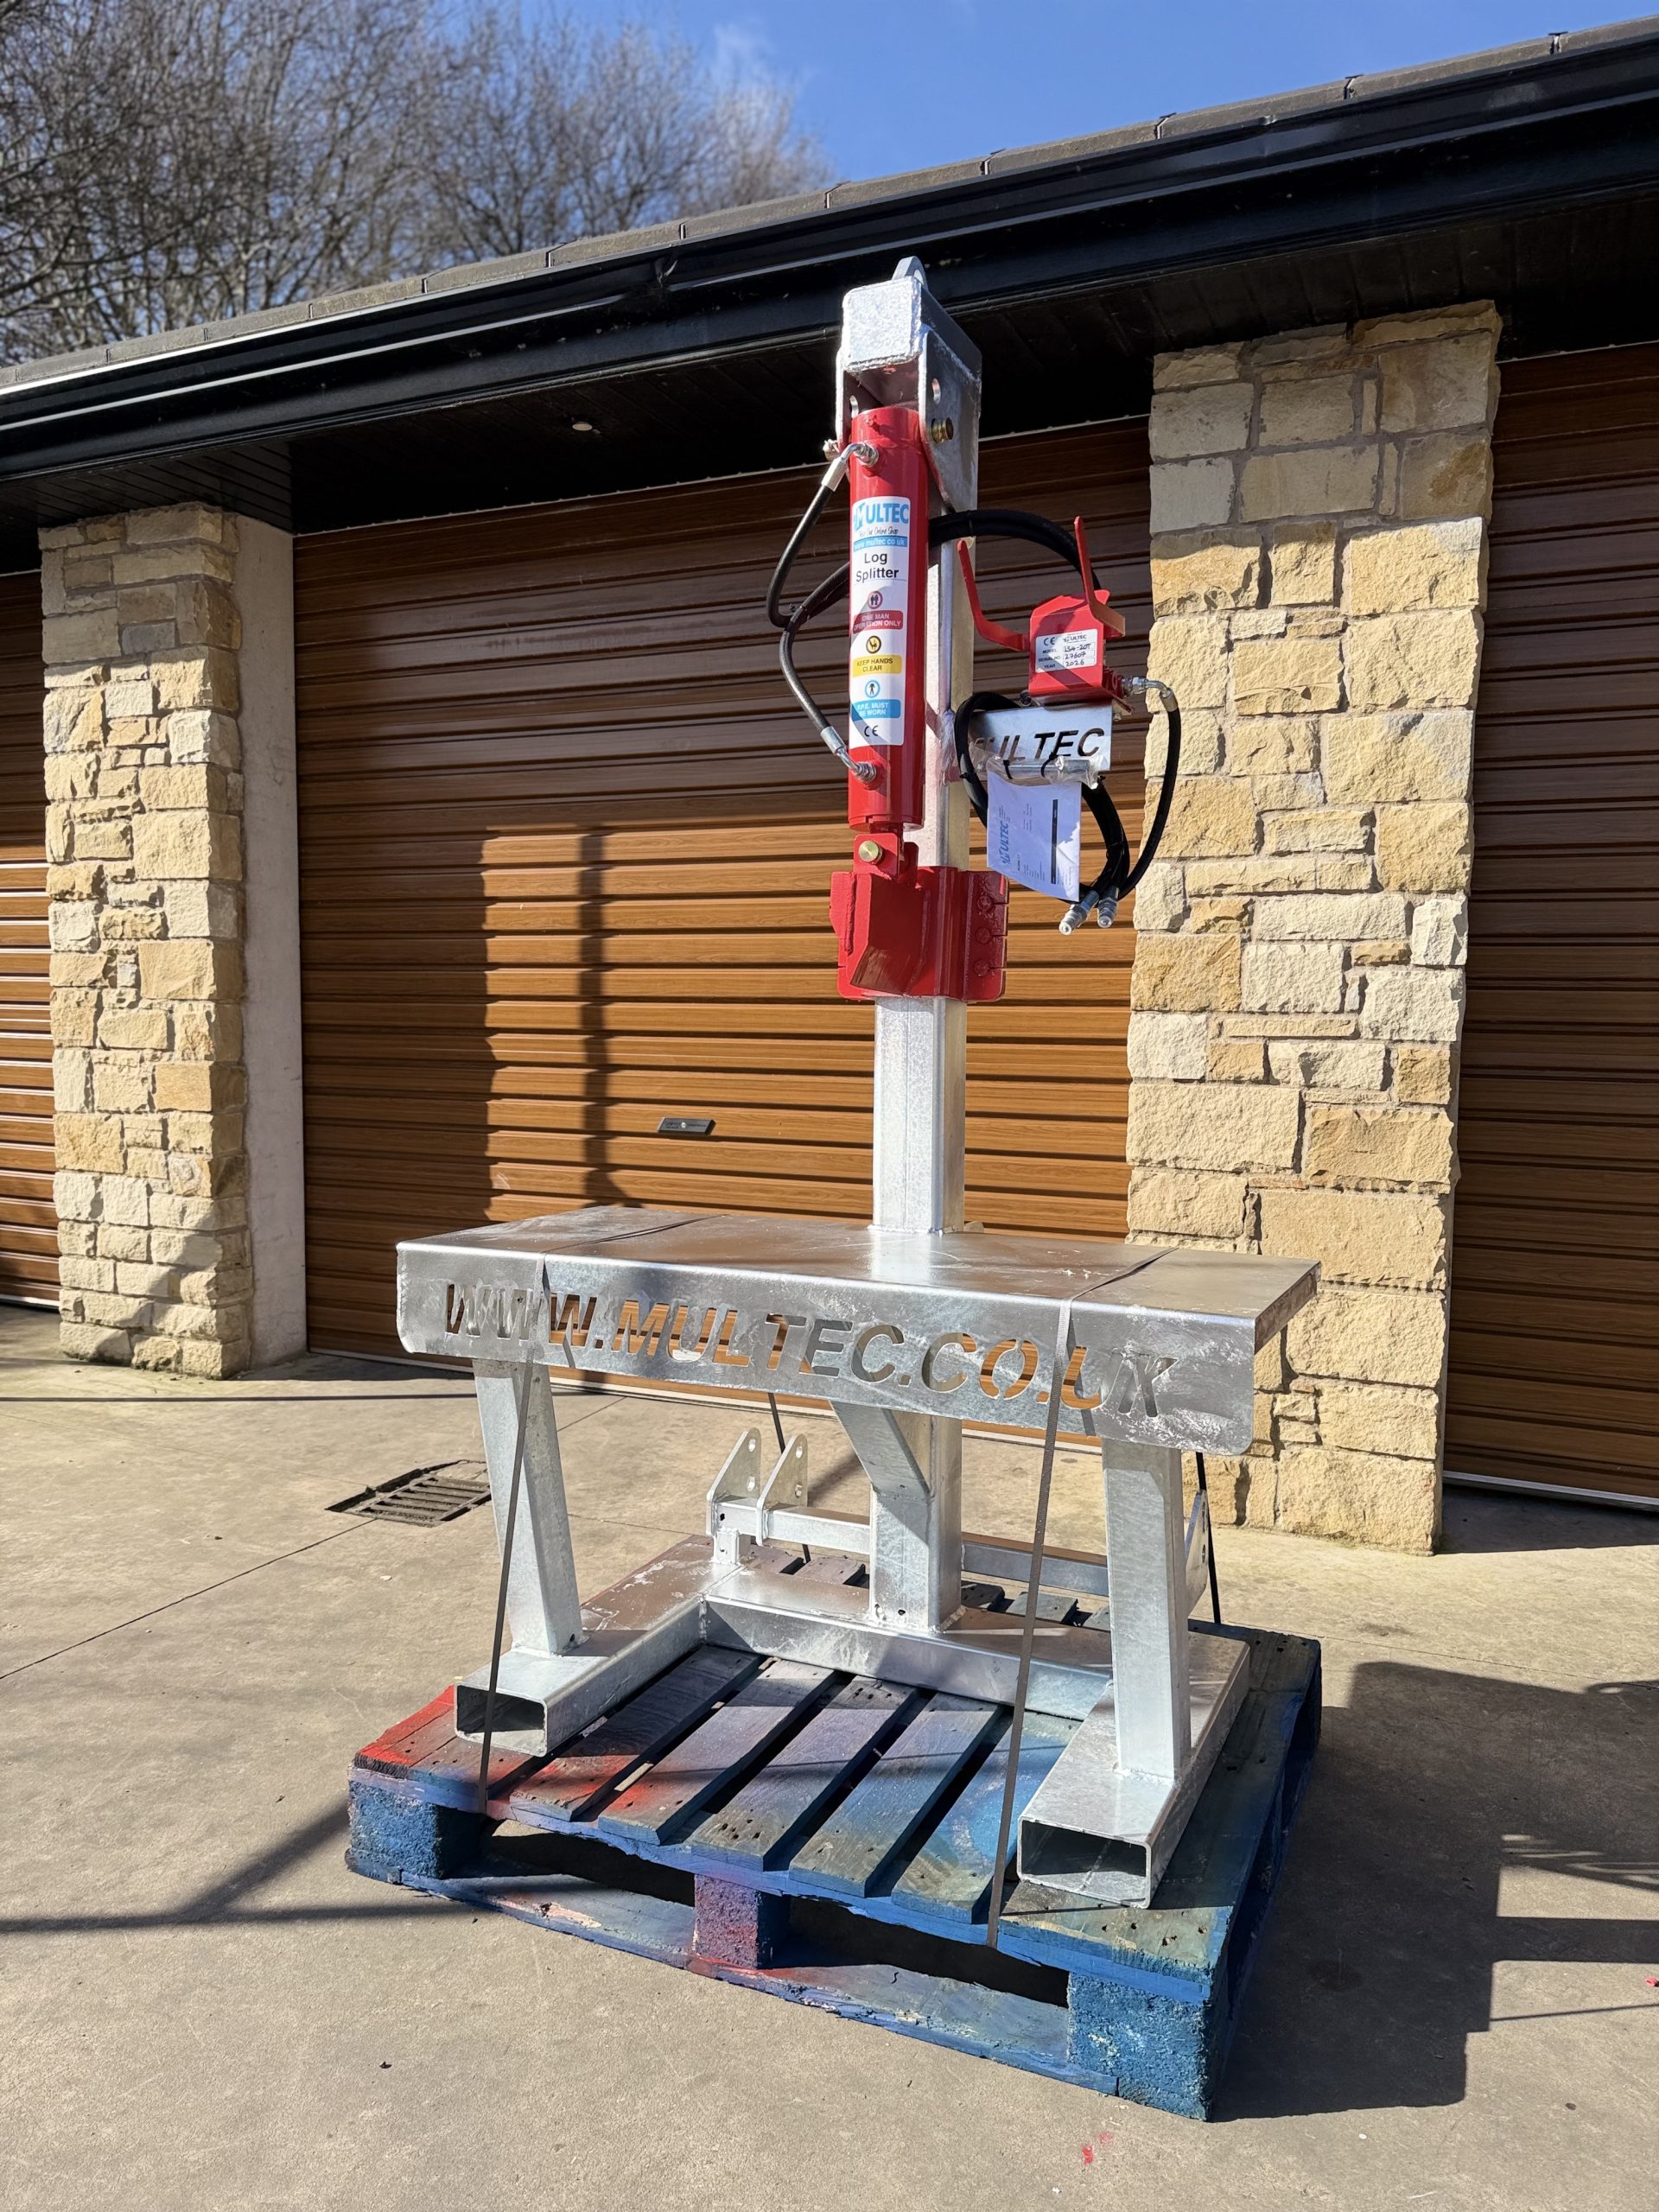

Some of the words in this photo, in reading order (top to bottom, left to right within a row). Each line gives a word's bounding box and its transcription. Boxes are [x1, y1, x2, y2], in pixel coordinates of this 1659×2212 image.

[854, 502, 909, 531] MULTEC
[865, 553, 887, 564] Log
[856, 568, 899, 583] Splitter
[854, 620, 883, 631] OPERATION
